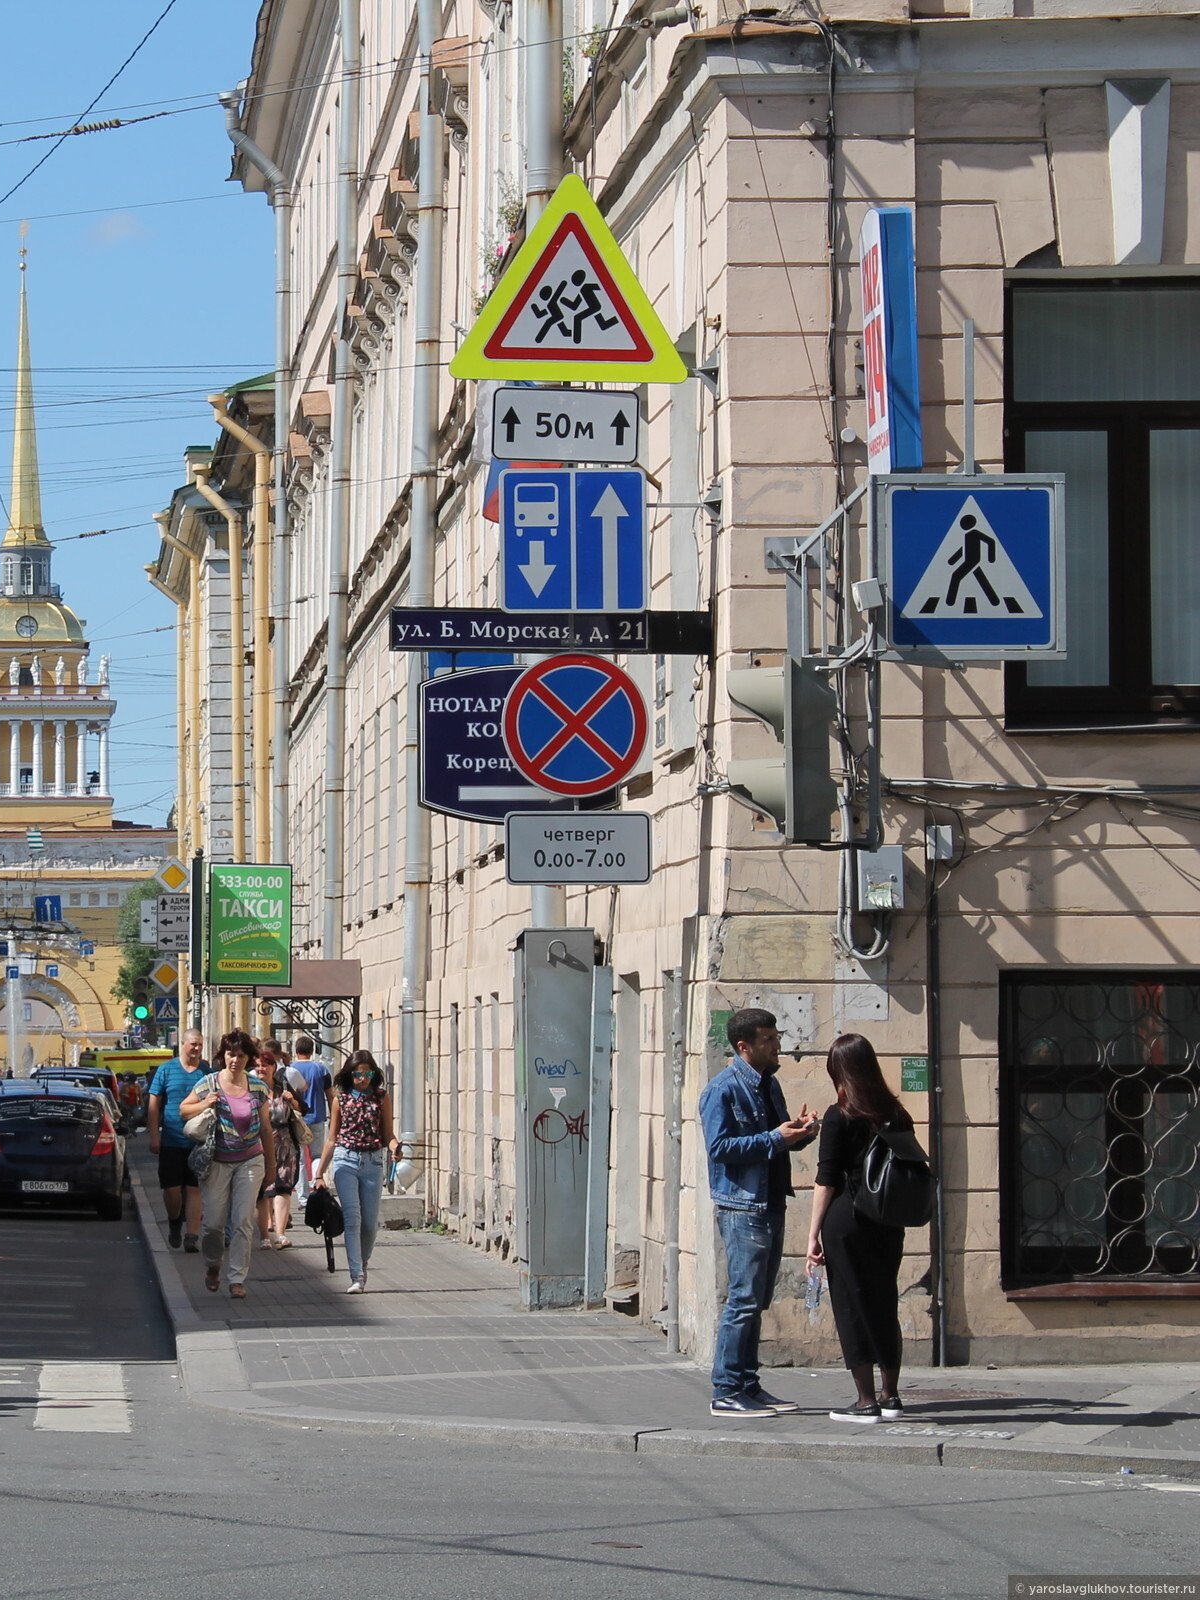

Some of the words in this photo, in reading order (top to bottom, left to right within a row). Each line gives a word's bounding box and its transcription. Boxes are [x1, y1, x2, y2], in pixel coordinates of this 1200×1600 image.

[535, 412, 594, 440] 50м
[397, 624, 431, 641] ул.
[440, 621, 461, 638] Б.
[470, 622, 581, 642] Морская,
[589, 626, 609, 642] д.
[619, 621, 645, 640] 21
[428, 697, 506, 713] НОТАР
[467, 722, 503, 738] КО
[447, 754, 517, 773] Корец
[544, 829, 615, 845] четверг
[534, 849, 626, 867] 0.00-7.00
[218, 875, 283, 889] 333-00-00
[218, 899, 283, 918] ТАКСИ
[220, 961, 278, 970] ТАКСОВИЧКОФ.РФ
